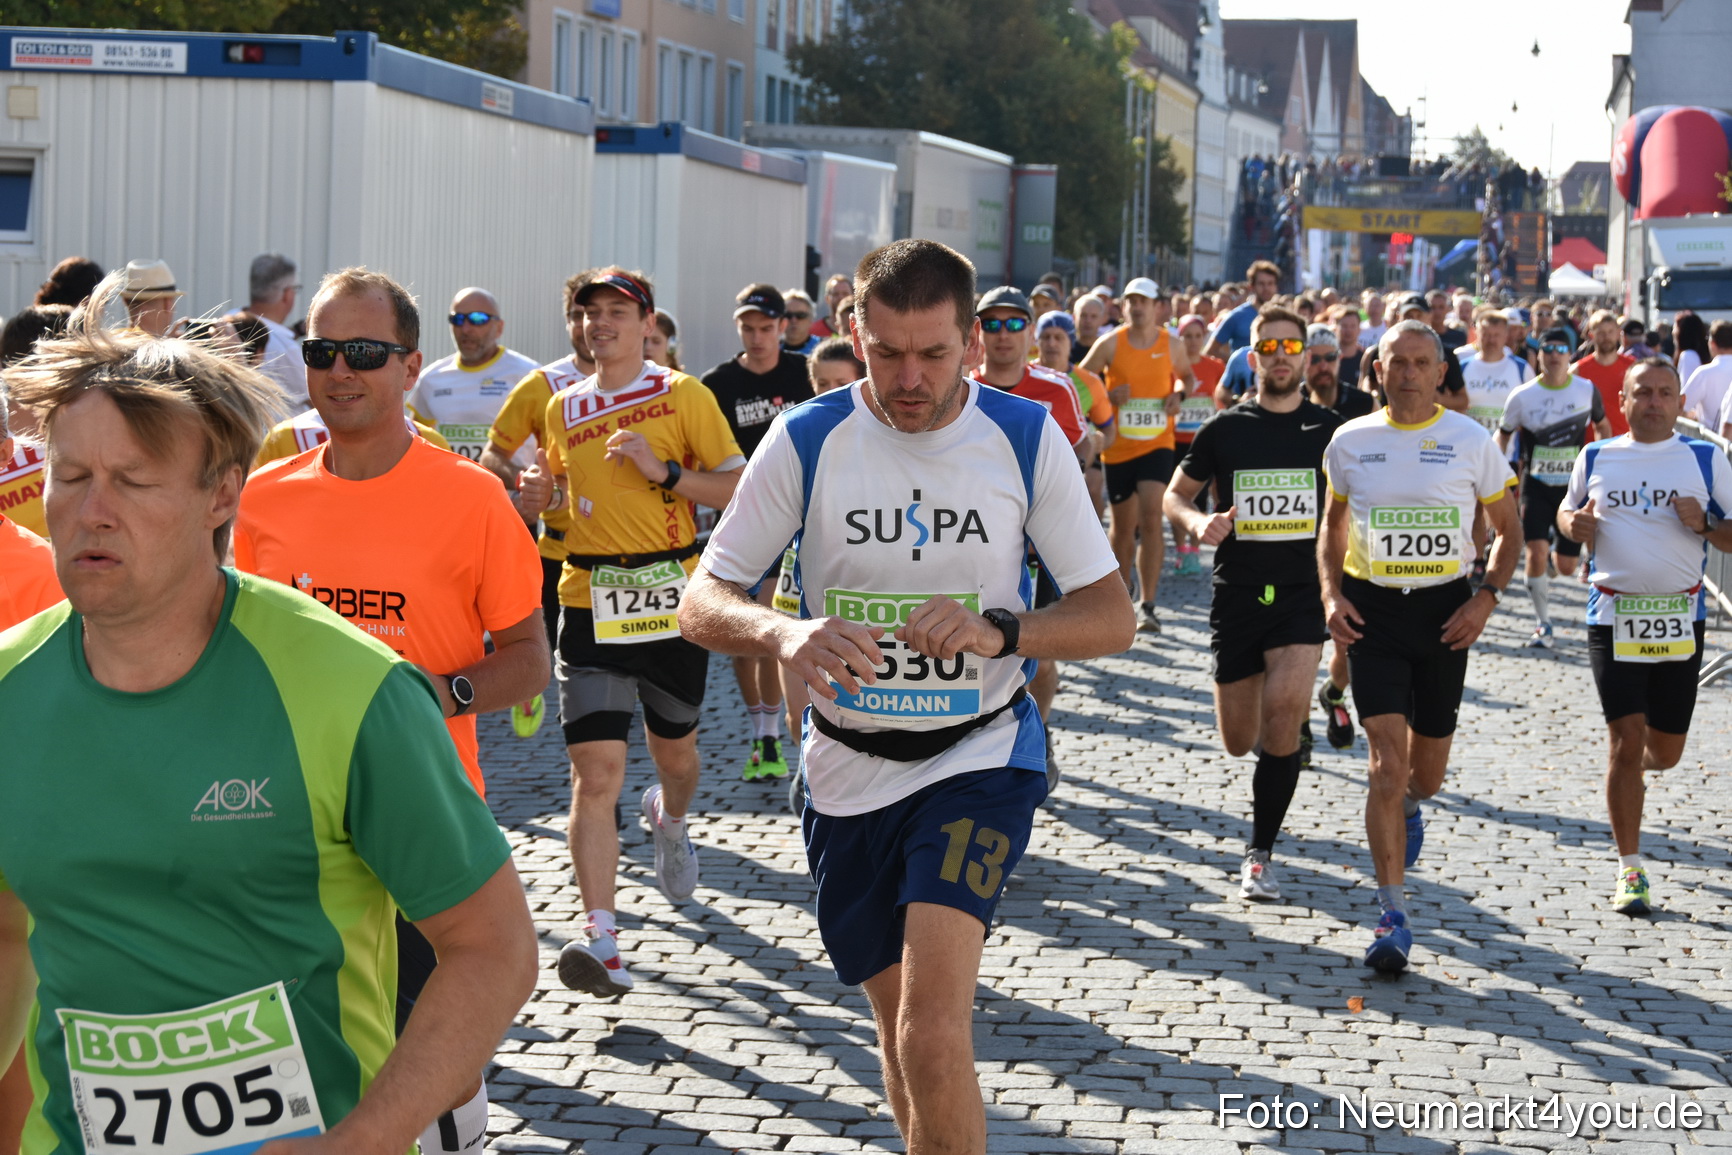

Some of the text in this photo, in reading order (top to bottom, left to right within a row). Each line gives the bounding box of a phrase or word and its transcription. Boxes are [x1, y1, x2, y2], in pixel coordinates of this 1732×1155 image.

[16, 43, 36, 54] TOI
[39, 43, 57, 55] TOI
[1361, 213, 1421, 229] START
[1469, 378, 1509, 390] SUSPA
[567, 402, 675, 450] MAX BÖGL
[1125, 413, 1160, 425] 1381
[1421, 440, 1437, 450] 20
[1538, 461, 1575, 473] 2648
[1242, 474, 1306, 487] BOCK
[1245, 495, 1307, 516] 1024
[846, 500, 989, 549] SUSPA
[1378, 511, 1449, 525] BOCK
[1243, 522, 1308, 531] ALEXANDER
[1381, 534, 1451, 557] 1209
[599, 565, 670, 586] BOCK
[1386, 564, 1444, 574] EDMUND
[292, 573, 406, 621] RBER
[605, 587, 681, 615] 1243
[1621, 598, 1683, 611] BOCK
[621, 619, 669, 633] SIMON
[1624, 618, 1683, 639] 1293
[1640, 645, 1669, 654] AKIN
[854, 694, 951, 712] JOHANN
[193, 777, 273, 812] AOK
[191, 811, 276, 822] Die Gesundheitskasse.
[939, 817, 1010, 900] 13
[79, 1008, 261, 1063] BOCK
[93, 1064, 284, 1146] 2705
